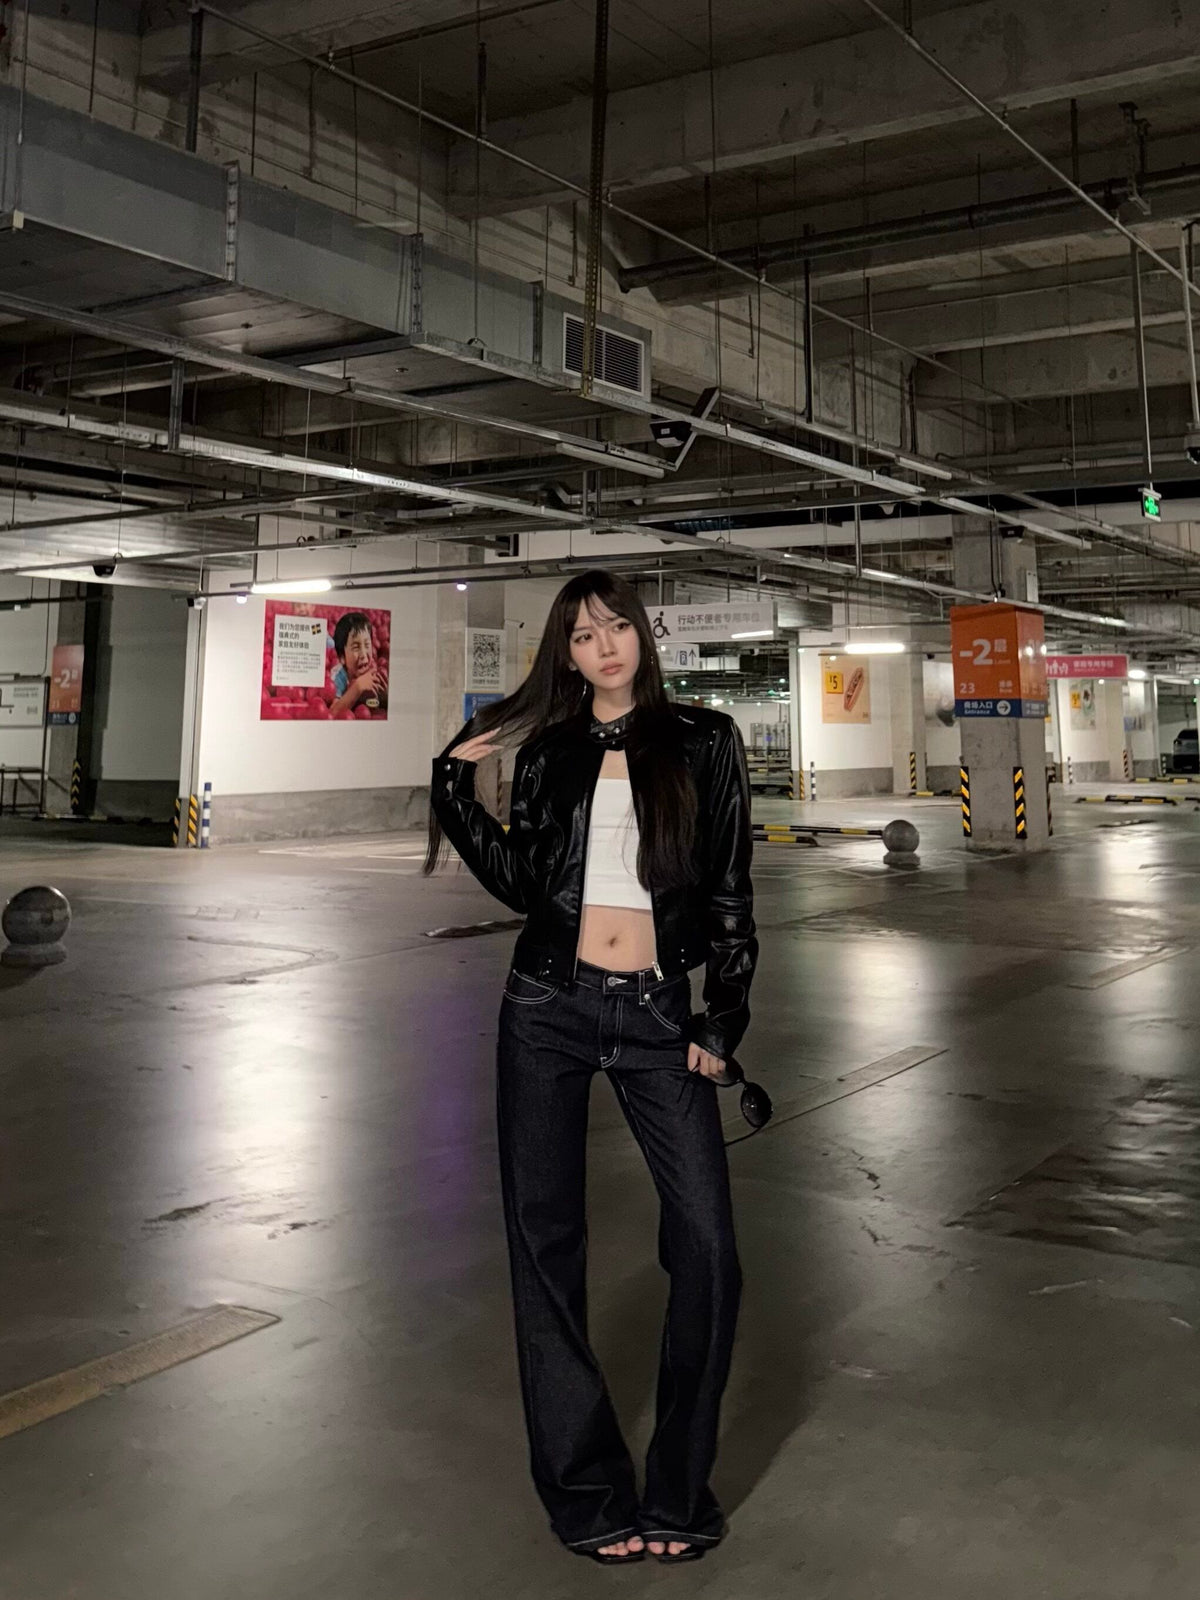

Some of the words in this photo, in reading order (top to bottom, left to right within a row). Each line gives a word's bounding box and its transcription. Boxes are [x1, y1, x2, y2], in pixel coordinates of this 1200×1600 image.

[678, 613, 760, 625] 行动不便者专用车位
[960, 683, 975, 694] 23
